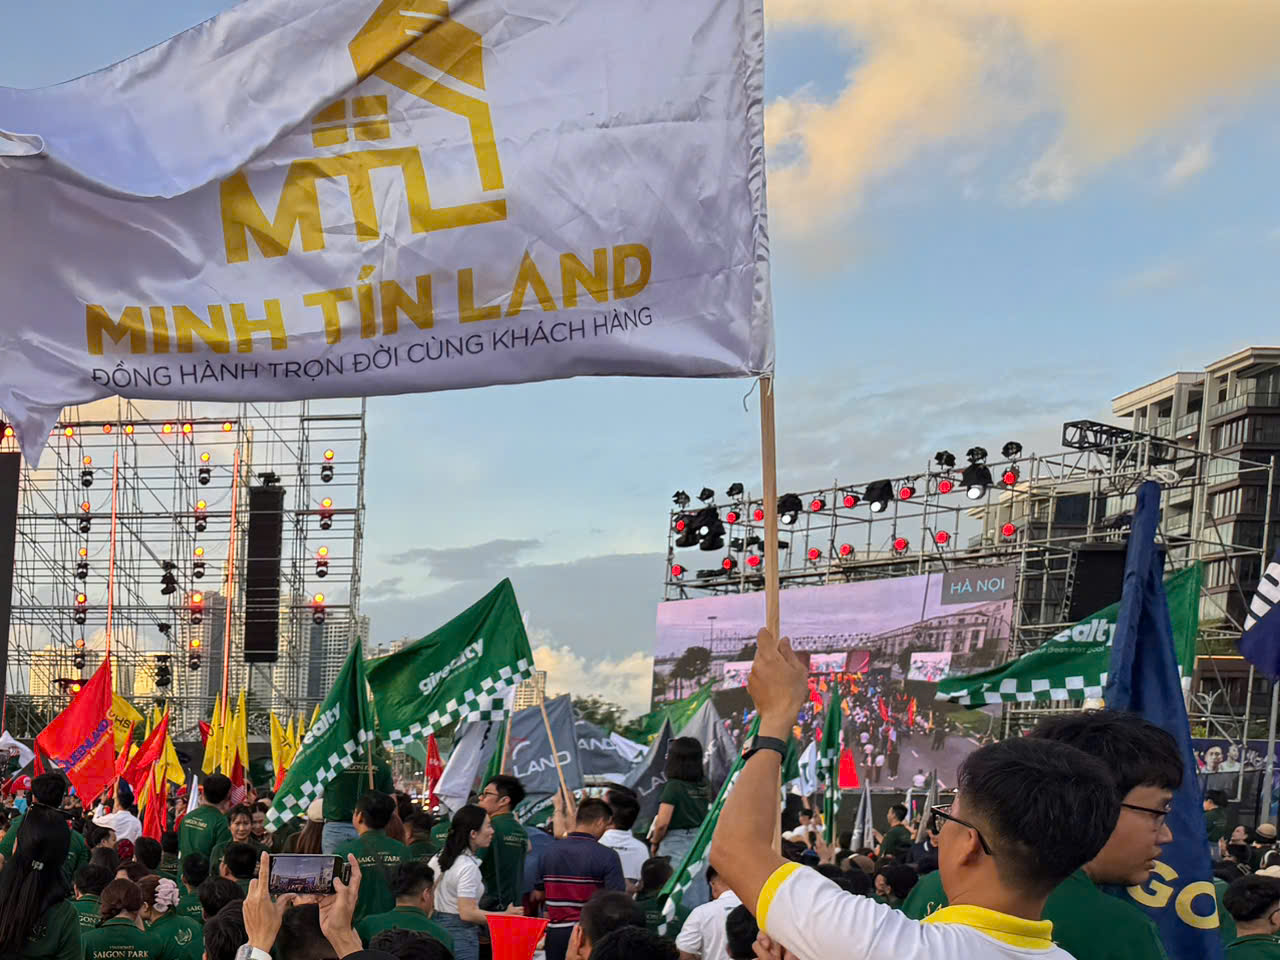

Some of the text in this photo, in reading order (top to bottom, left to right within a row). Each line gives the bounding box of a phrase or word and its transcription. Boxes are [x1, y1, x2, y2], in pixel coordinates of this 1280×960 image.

[220, 146, 507, 264] MTL
[86, 242, 652, 356] MINH TÍN LAND
[92, 307, 653, 388] ĐỒNG HÀNH TRỌN ĐỜI CÙNG KHÁCH HÀNG
[950, 577, 1005, 595] HÀ NỘI
[513, 750, 571, 778] LAND
[93, 949, 149, 959] SAIGON PARK
